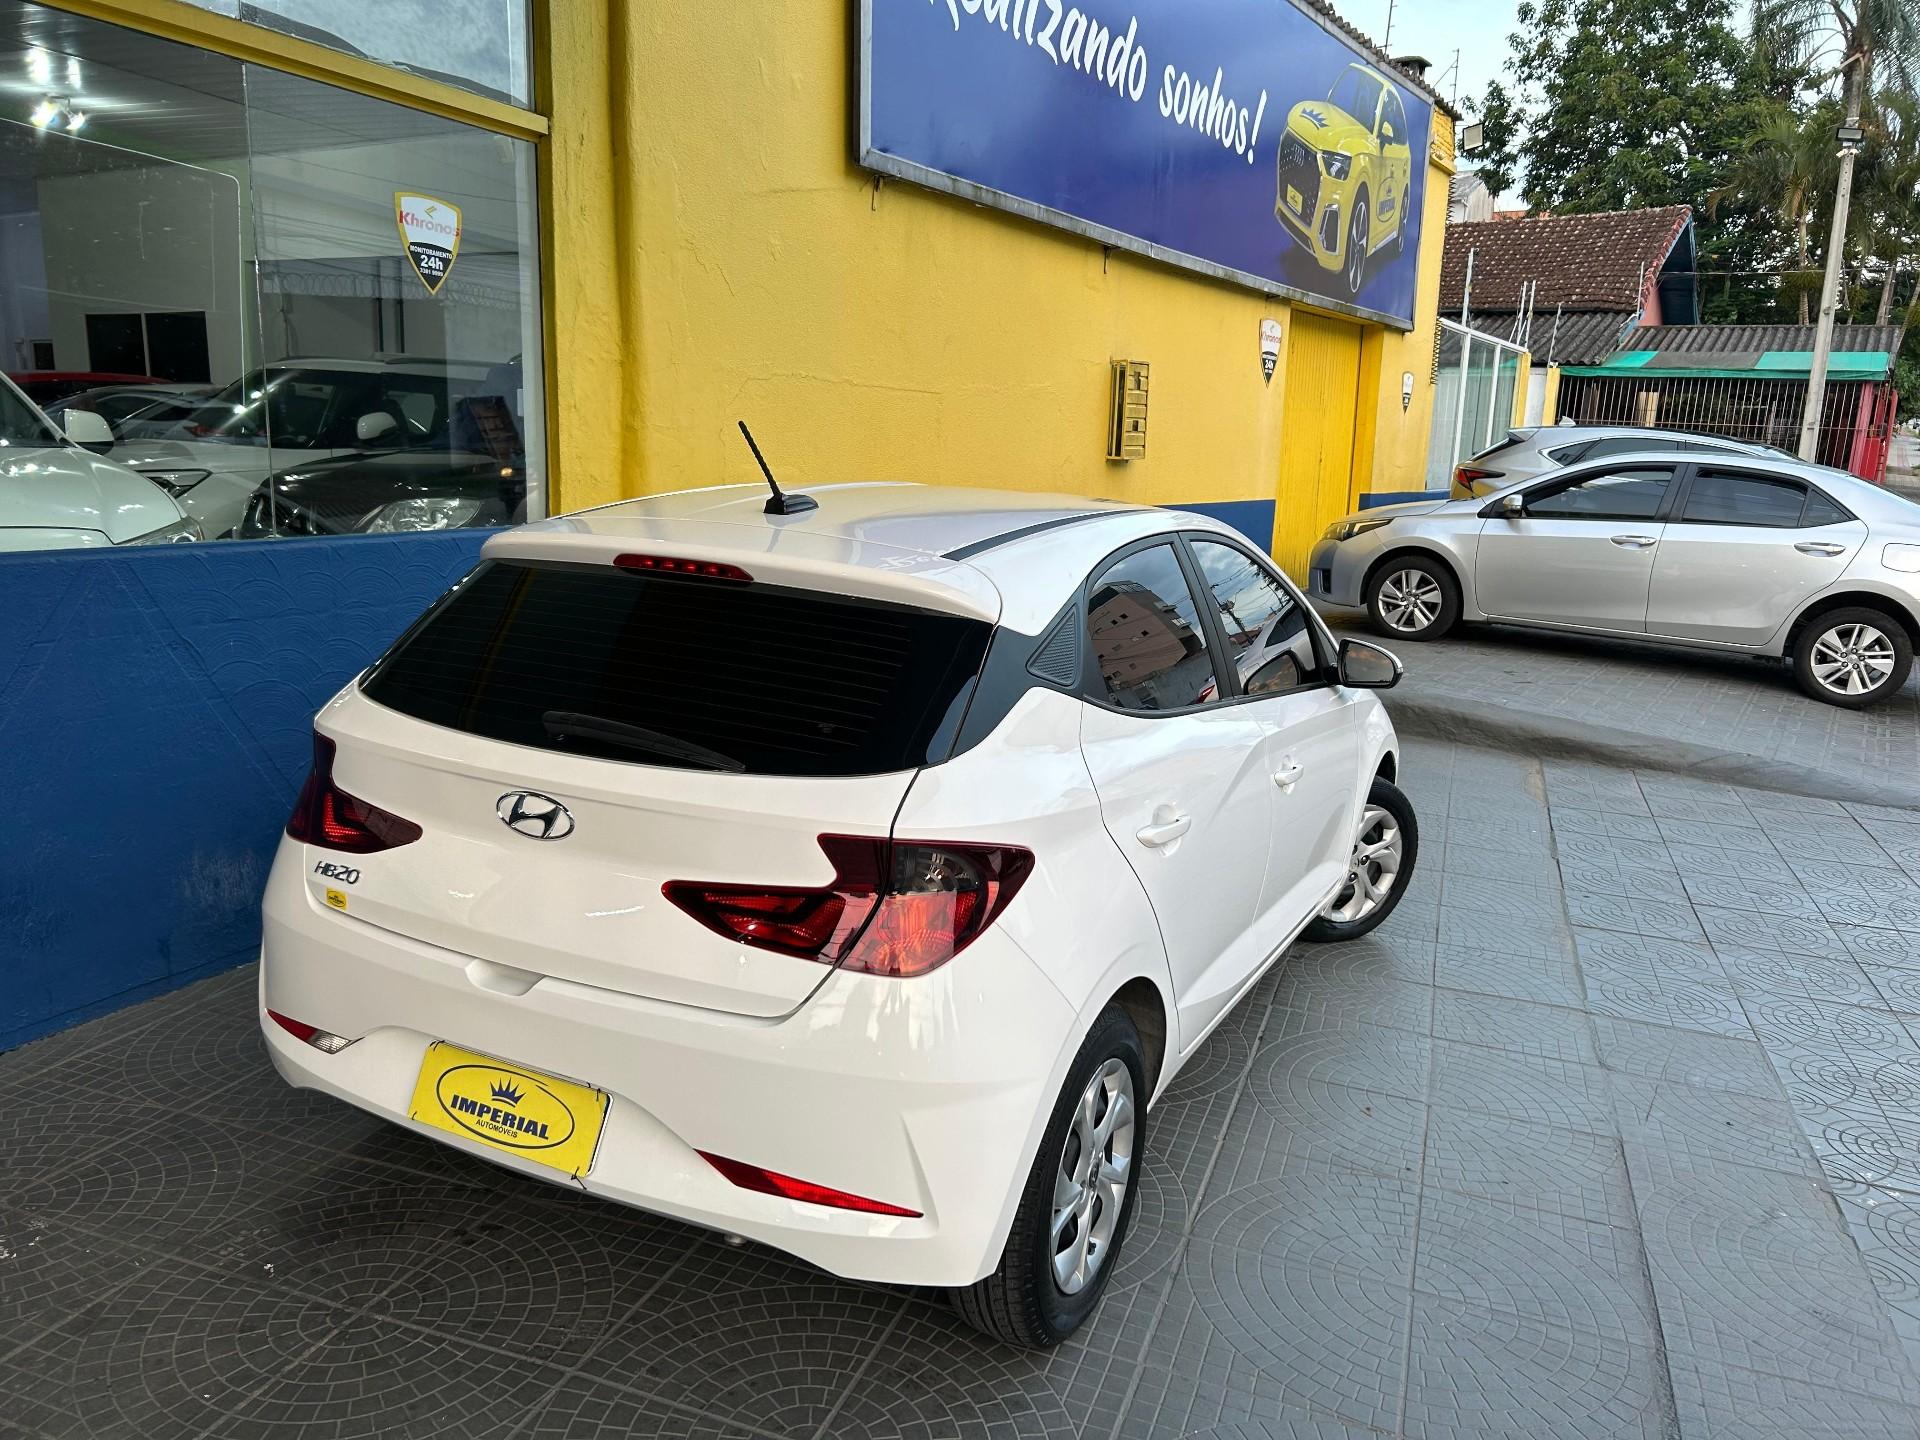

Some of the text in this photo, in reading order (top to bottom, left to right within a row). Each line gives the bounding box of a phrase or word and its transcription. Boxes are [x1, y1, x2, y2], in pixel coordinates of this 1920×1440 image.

[1159, 64, 1267, 165] sonhos!
[399, 210, 461, 237] Khronos
[409, 244, 453, 259] MONITORAMENTO
[420, 254, 444, 271] 24h
[314, 860, 361, 885] HB20
[450, 1094, 549, 1140] IMPERIAL
